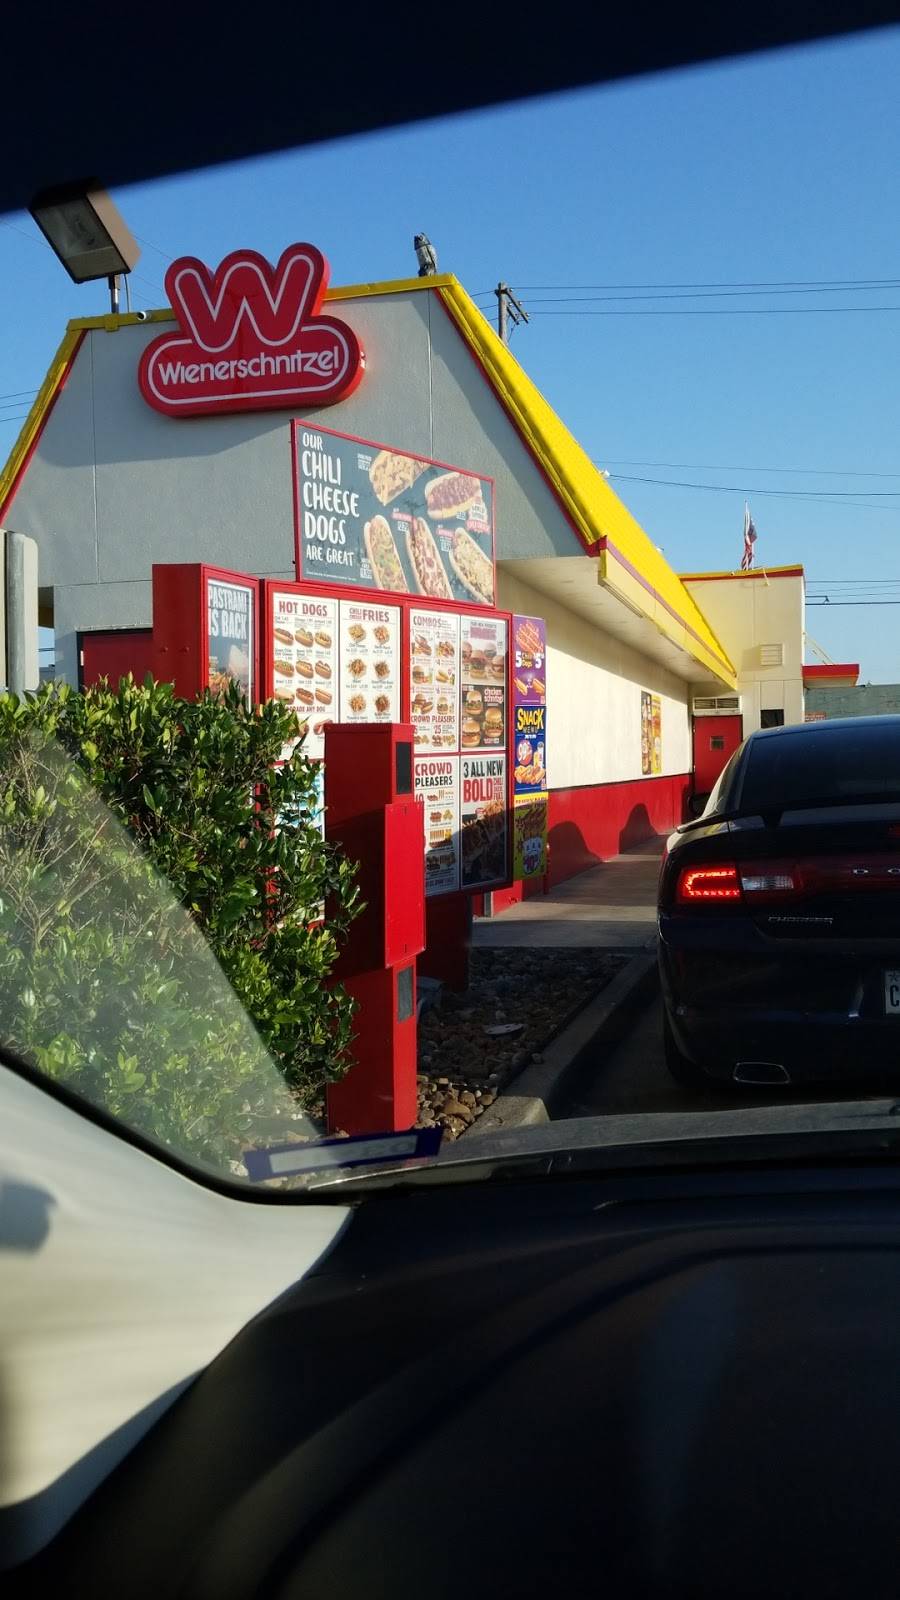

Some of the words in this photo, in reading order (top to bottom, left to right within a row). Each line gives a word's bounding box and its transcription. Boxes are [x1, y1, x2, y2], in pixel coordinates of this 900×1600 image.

[158, 346, 339, 386] Wienerschnitzel
[302, 432, 324, 451] OUR
[302, 451, 341, 486] CHILI
[303, 481, 360, 518] CHEESE
[304, 511, 346, 545] DOGS
[306, 544, 324, 562] ARE
[326, 547, 355, 567] GREAT
[208, 584, 248, 612] PASTRAMI
[279, 601, 299, 614] HOT
[302, 603, 328, 617] DOGS
[208, 608, 219, 637] IS
[221, 610, 247, 640] BACK
[362, 608, 390, 623] FRIES
[515, 651, 523, 668] 5
[517, 707, 545, 731] SNACK
[415, 762, 453, 777] CROWD
[463, 761, 469, 778] 3
[471, 761, 486, 777] ALL
[486, 760, 504, 776] NEW
[415, 776, 453, 788] PLEASERS
[463, 778, 493, 803] BOLD
